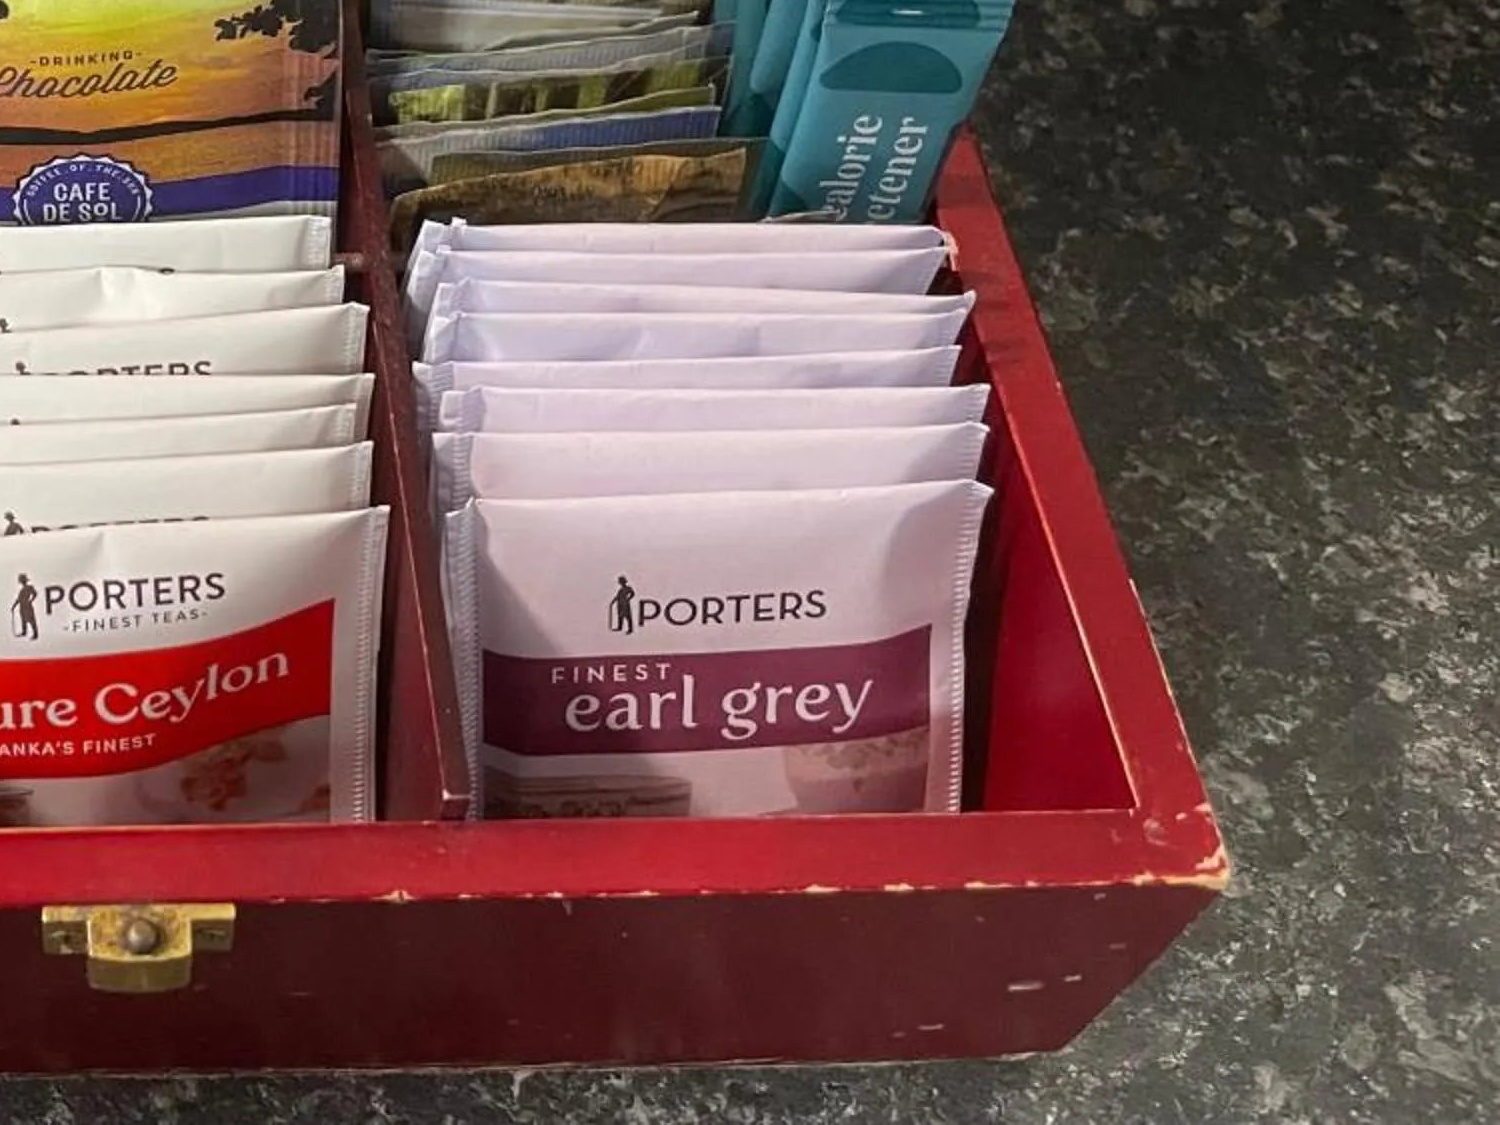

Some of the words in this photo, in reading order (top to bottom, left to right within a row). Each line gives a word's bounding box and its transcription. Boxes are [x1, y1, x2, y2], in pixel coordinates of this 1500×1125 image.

[53, 182, 112, 202] CAFE
[42, 202, 72, 222] DE
[77, 202, 123, 222] SOL
[44, 572, 226, 616] PORTERS
[637, 589, 827, 627] PORTERS
[94, 651, 291, 724] Ceylon
[551, 662, 672, 685] FINEST
[564, 673, 699, 733] earl
[720, 678, 875, 741] grey
[82, 732, 157, 755] FINEST
